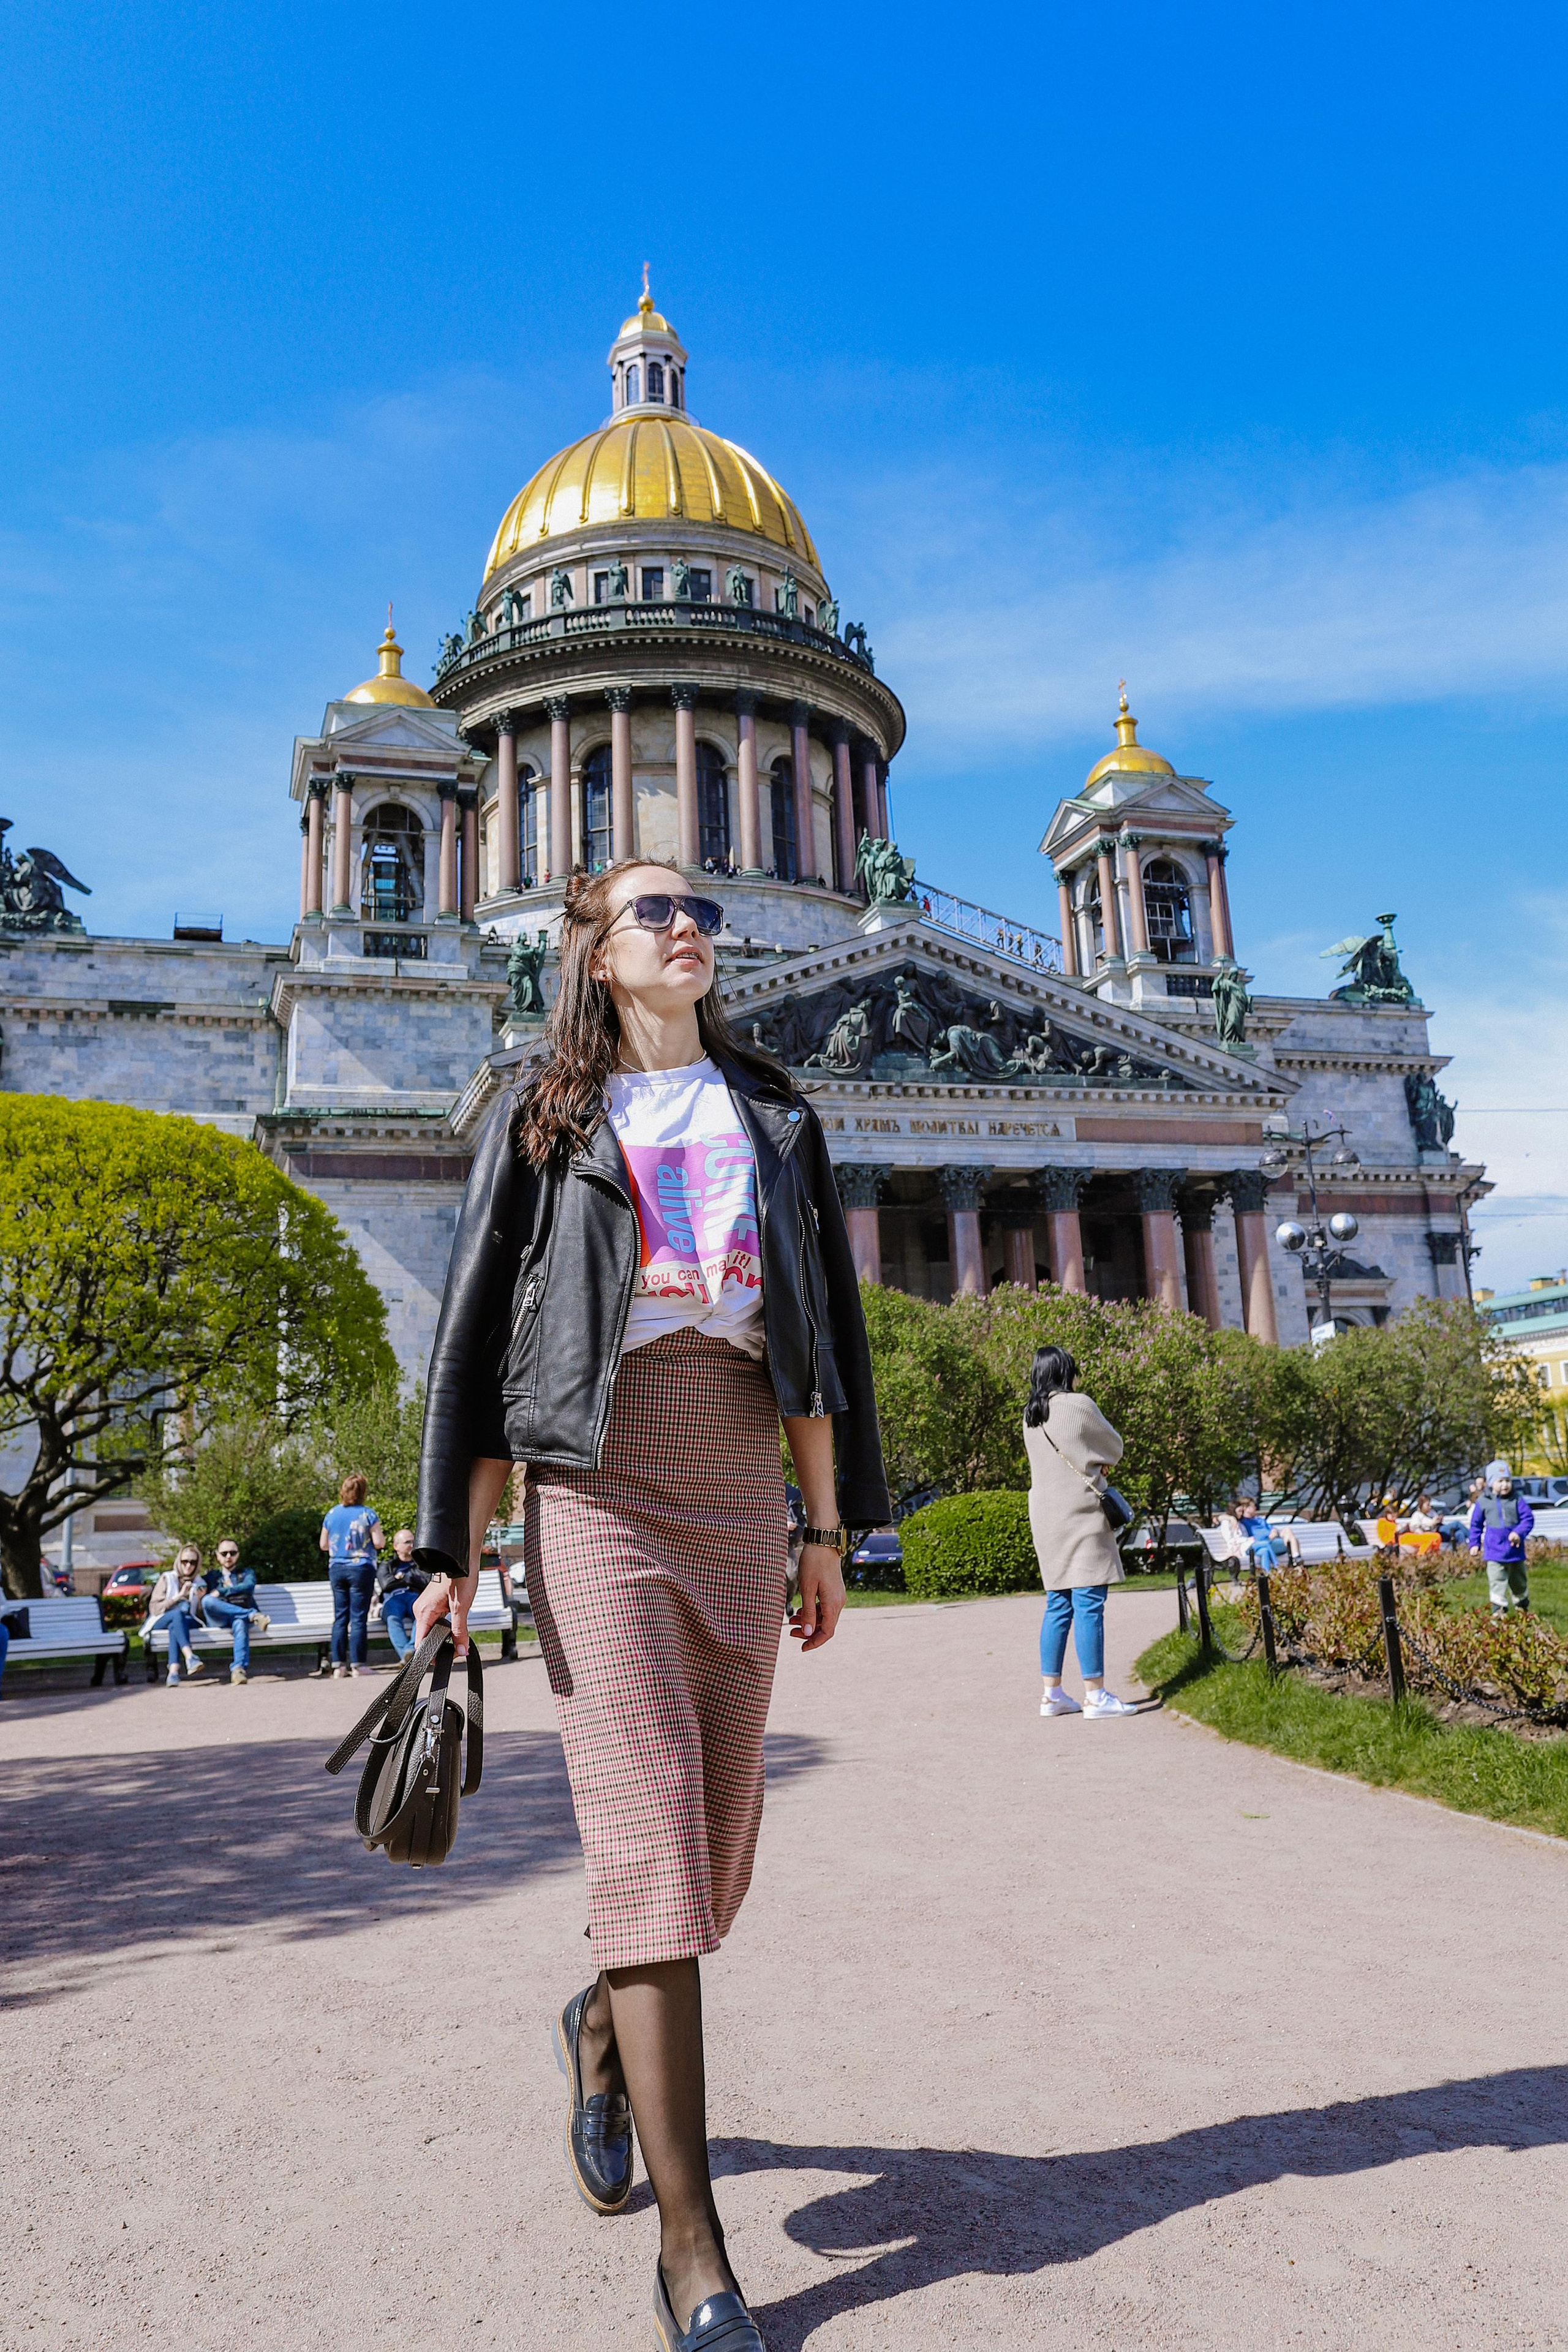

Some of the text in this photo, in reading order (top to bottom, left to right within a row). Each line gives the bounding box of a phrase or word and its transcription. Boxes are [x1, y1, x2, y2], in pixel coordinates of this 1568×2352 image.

[657, 1164, 703, 1254] alive
[641, 1272, 671, 1289] you
[677, 1269, 699, 1280] can
[733, 1251, 751, 1268] it!
